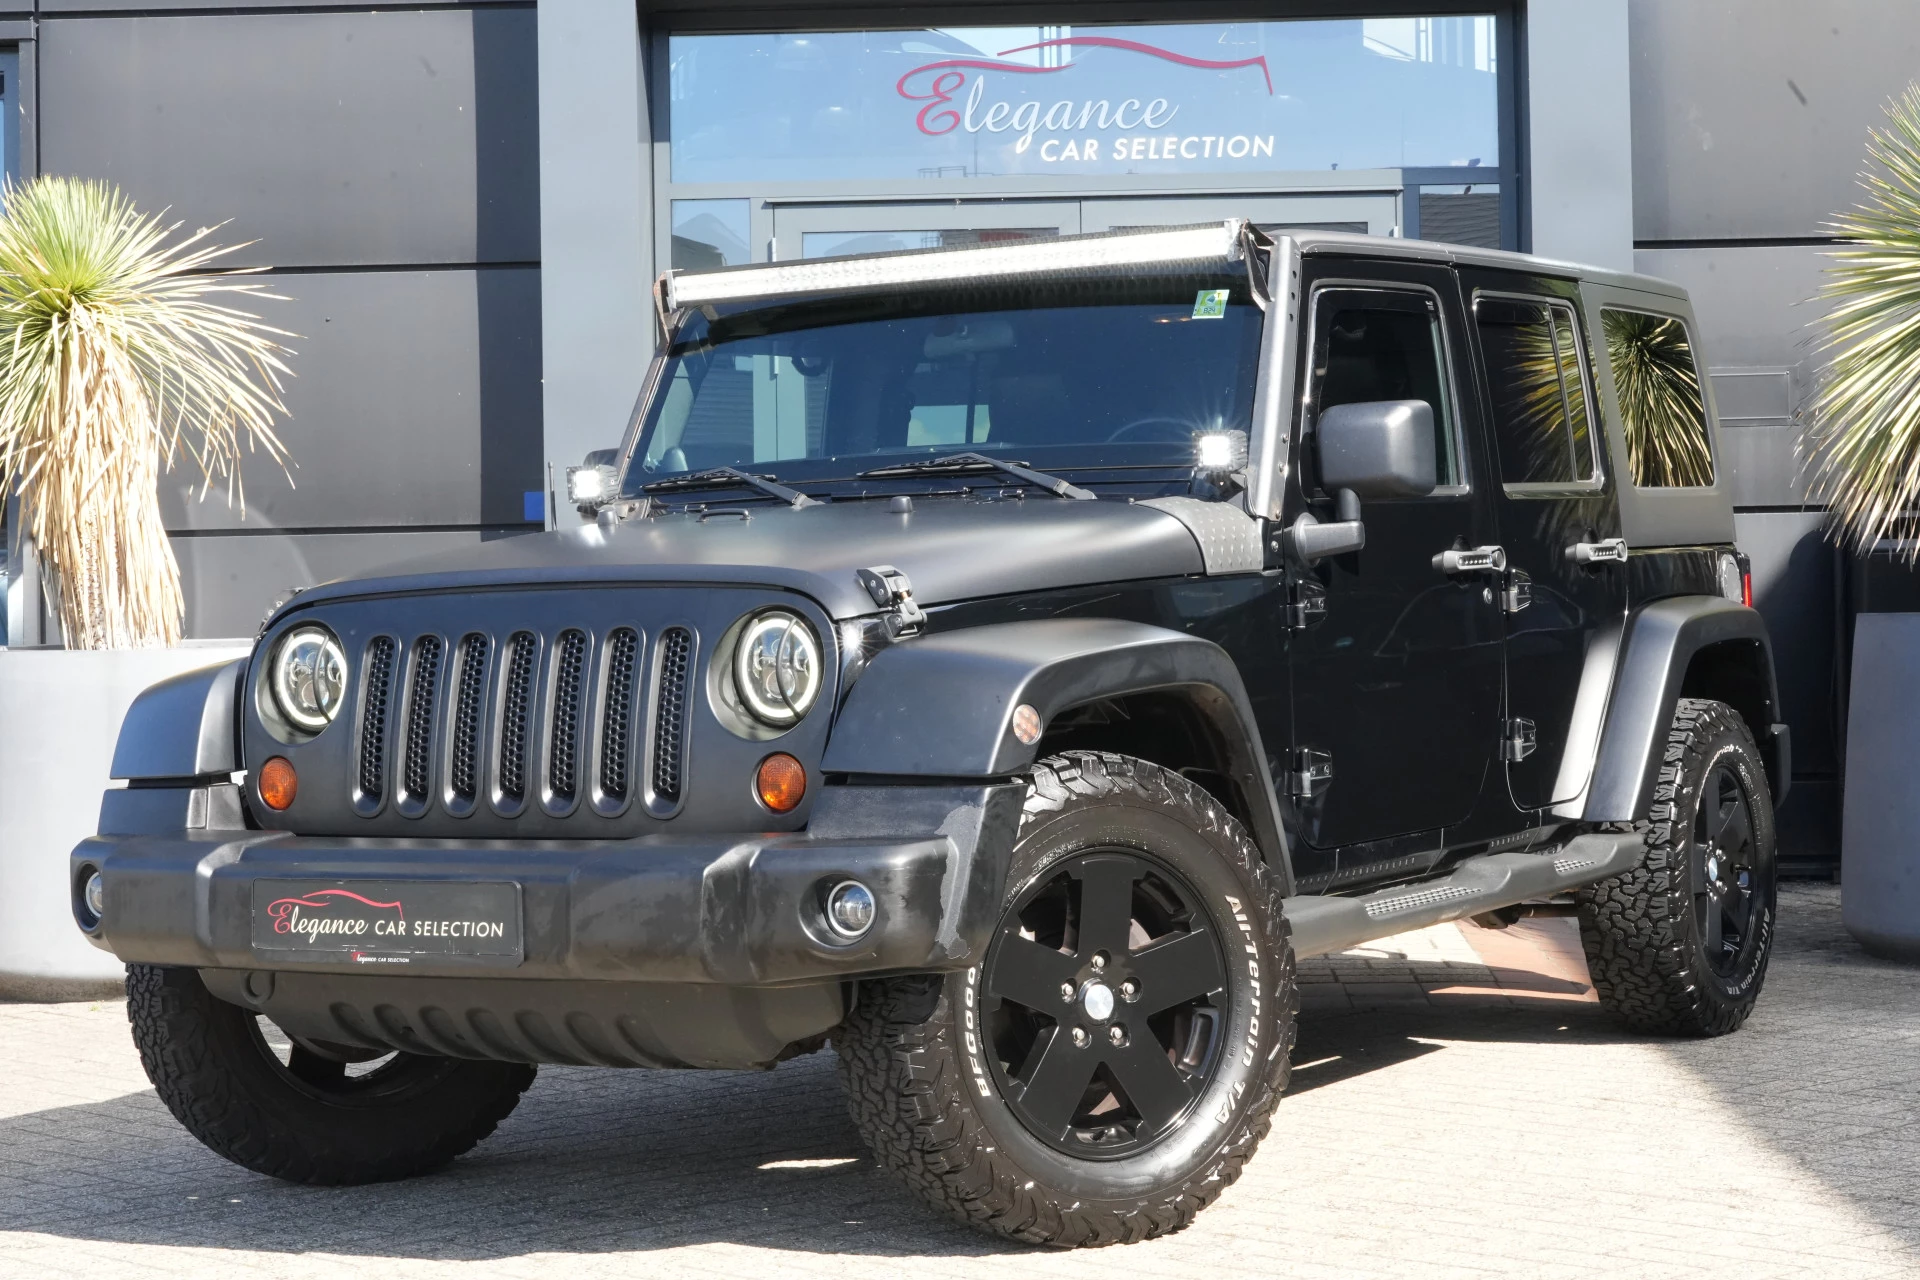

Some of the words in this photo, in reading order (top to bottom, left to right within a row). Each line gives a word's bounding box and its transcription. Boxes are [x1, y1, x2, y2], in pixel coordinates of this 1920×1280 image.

[896, 60, 1180, 154] Elegance
[1039, 139, 1100, 163] CAR
[1112, 135, 1276, 160] SELECTION
[267, 898, 369, 943] Elegance
[374, 920, 406, 936] CAR
[413, 921, 504, 938] SELECTION
[1224, 895, 1261, 1067] All-Terrain
[1214, 1080, 1246, 1125] T/A
